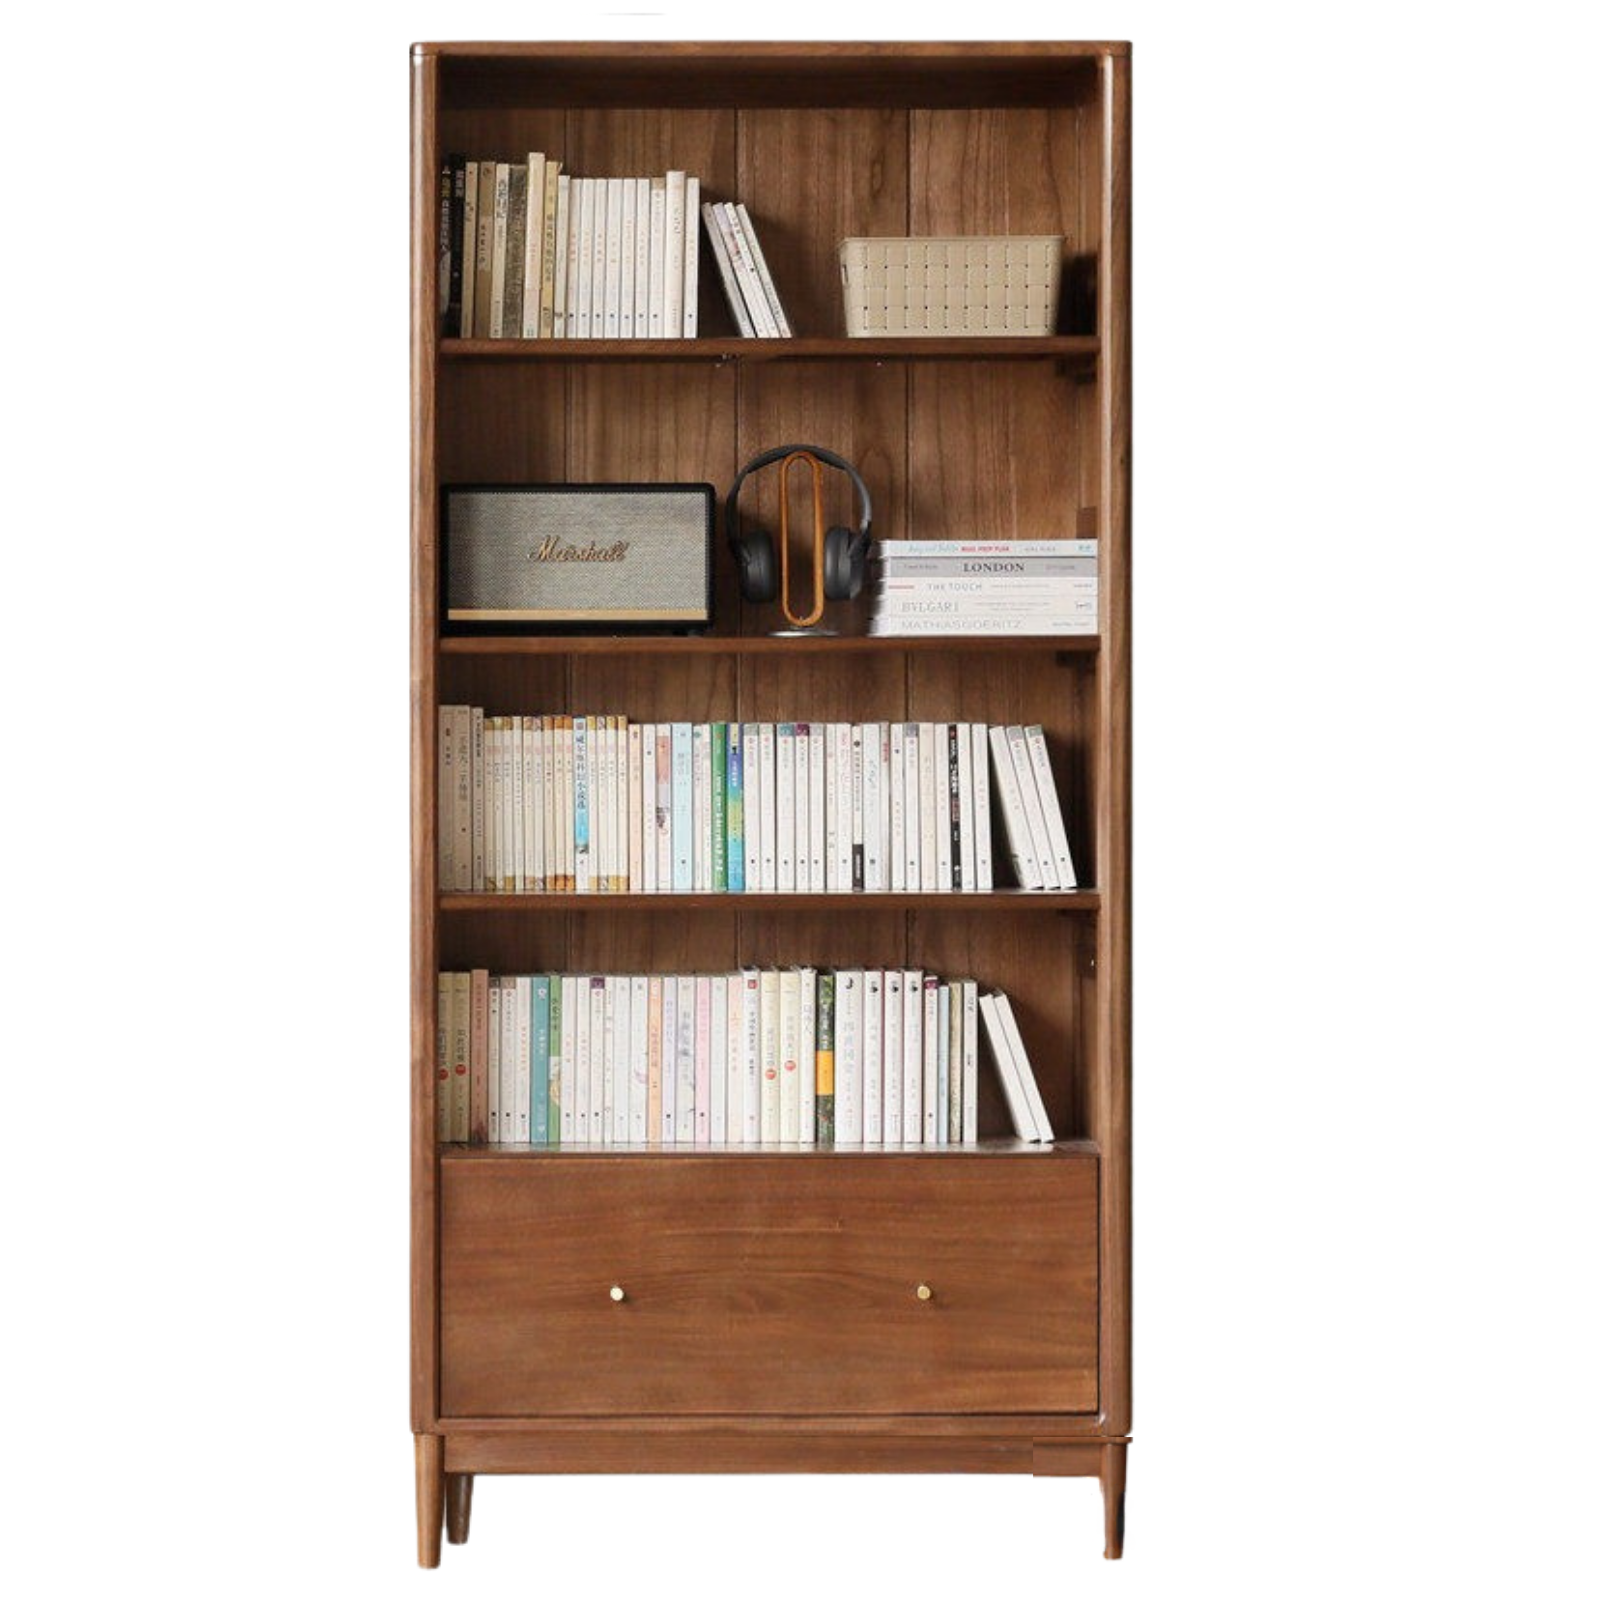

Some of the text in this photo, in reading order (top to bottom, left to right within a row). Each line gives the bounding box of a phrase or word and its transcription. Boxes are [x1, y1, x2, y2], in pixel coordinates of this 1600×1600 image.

[527, 535, 630, 562] Marshall
[963, 562, 1025, 573] LONDON
[927, 583, 945, 591] THE
[949, 582, 983, 591] TOUCH
